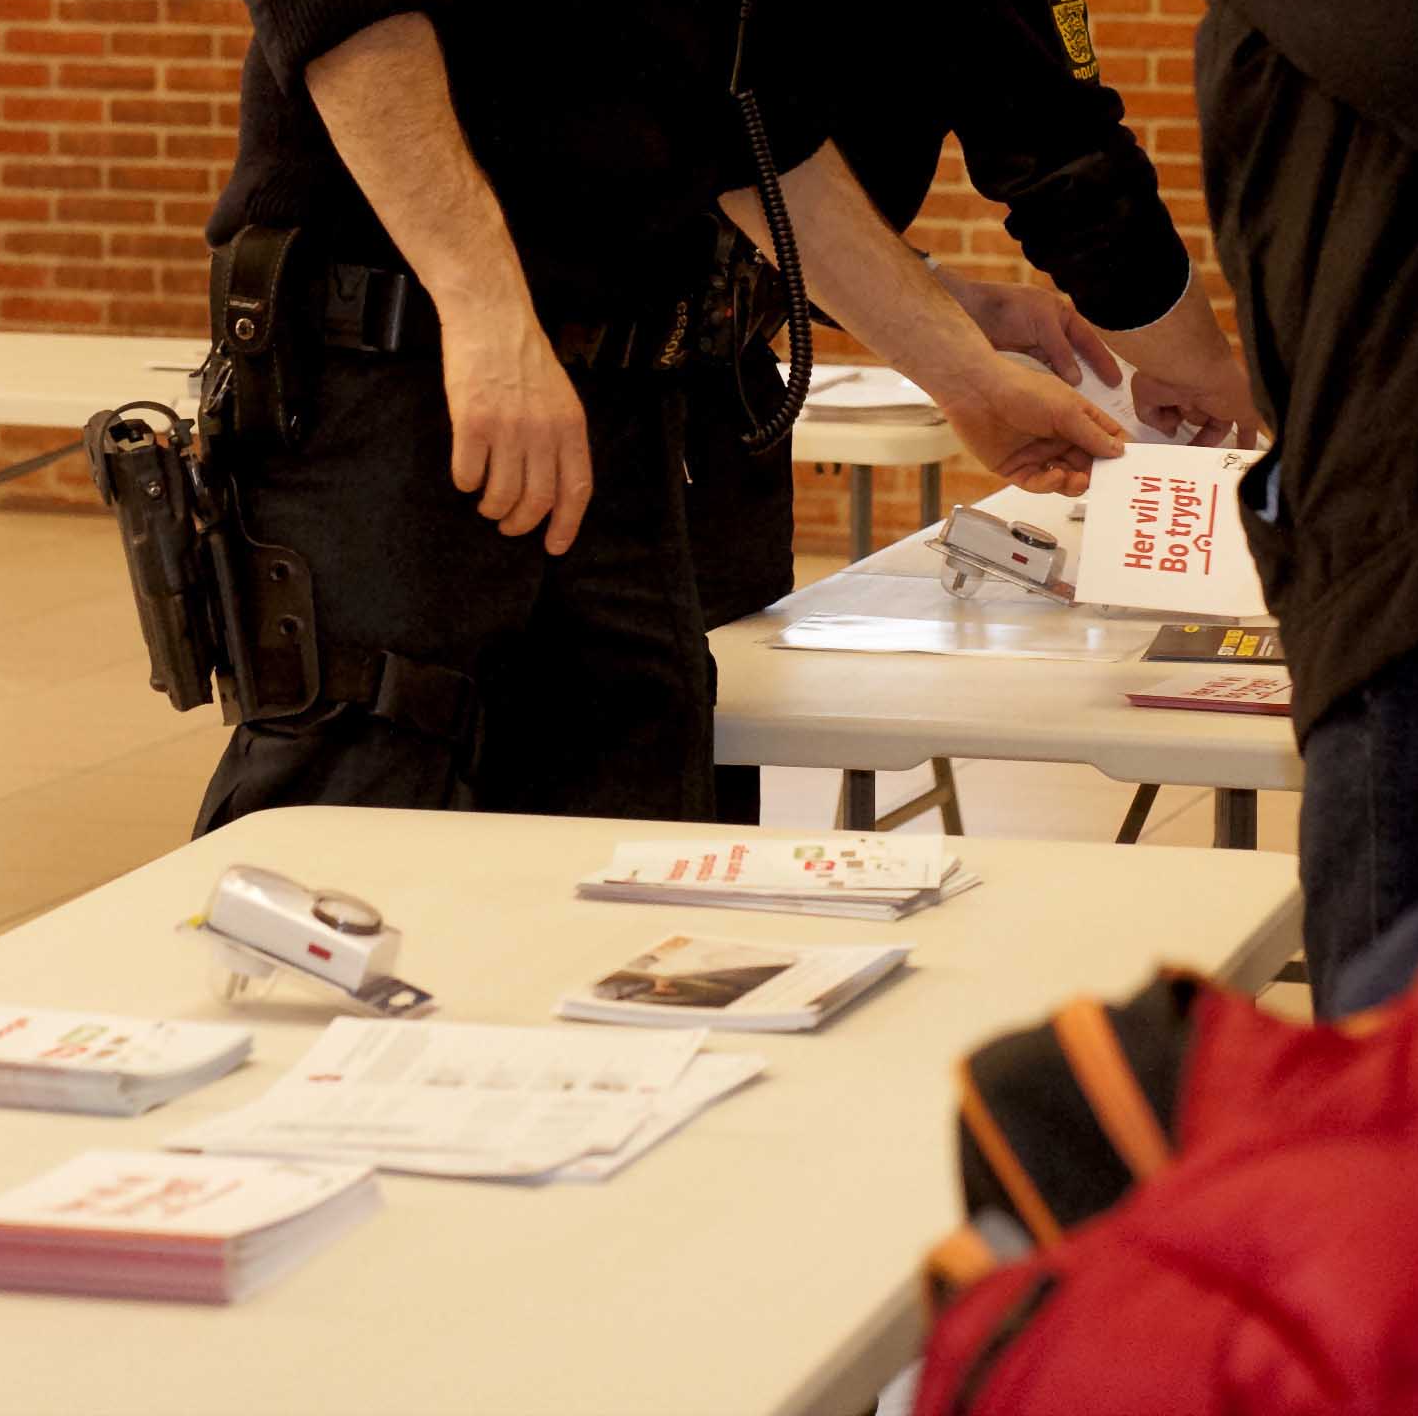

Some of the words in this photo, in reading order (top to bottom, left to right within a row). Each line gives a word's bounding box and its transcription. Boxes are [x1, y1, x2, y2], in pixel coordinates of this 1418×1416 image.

[1133, 475, 1162, 493] vi
[1129, 498, 1160, 524] vil
[1164, 477, 1203, 537] trygt!
[1124, 529, 1156, 570] Her
[1158, 543, 1190, 574] Bo
